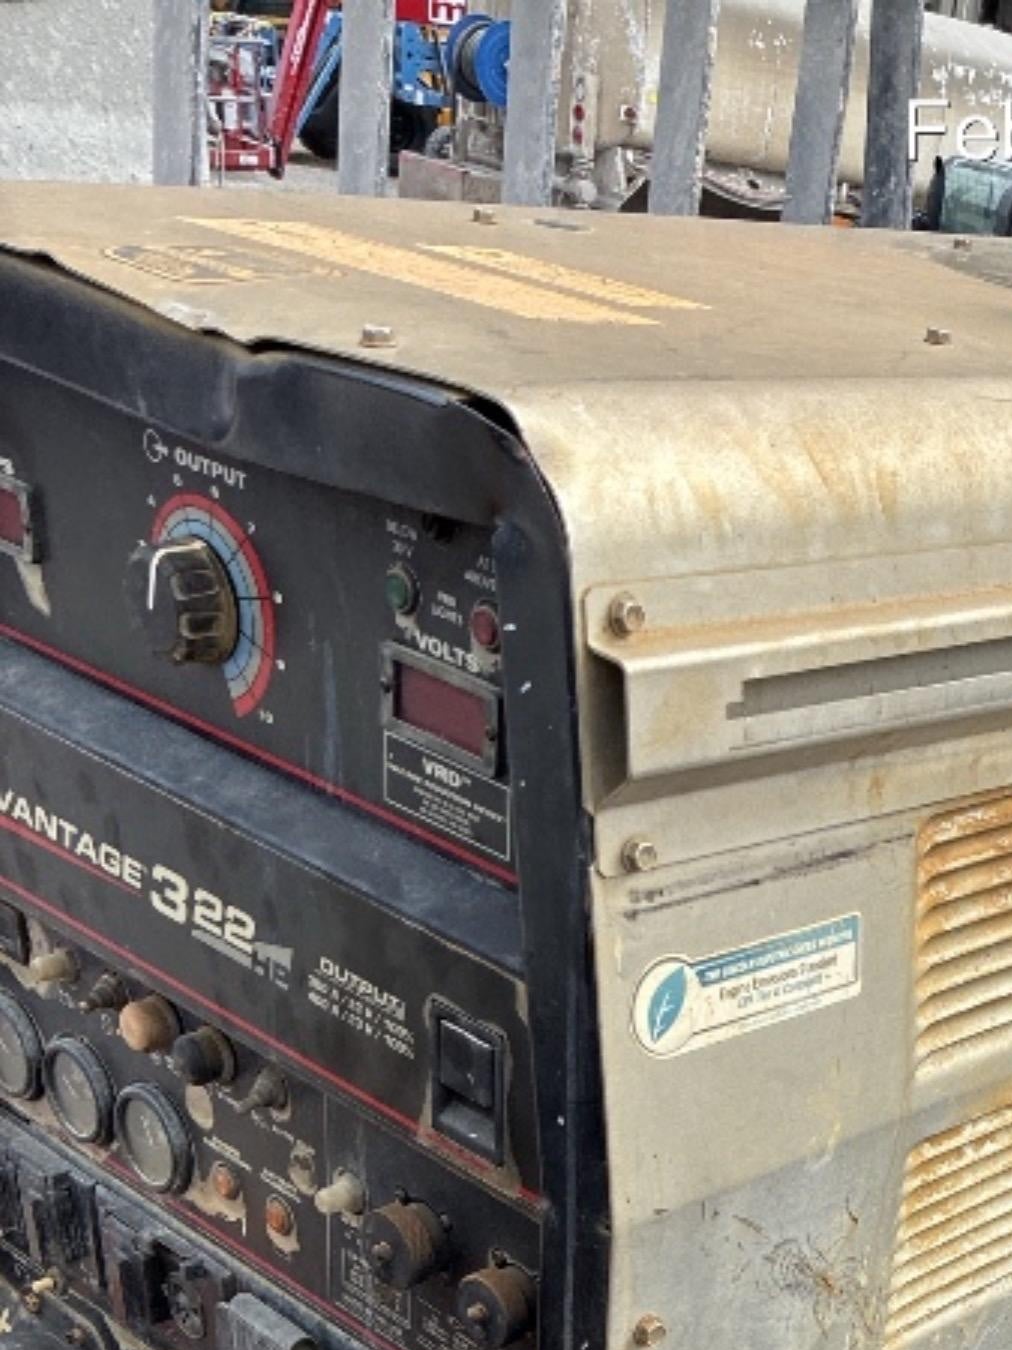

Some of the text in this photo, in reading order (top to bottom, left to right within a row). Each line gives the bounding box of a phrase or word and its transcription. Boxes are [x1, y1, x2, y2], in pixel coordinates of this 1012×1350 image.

[173, 446, 247, 489] OUTPUT
[413, 629, 480, 673] VOLTS
[0, 787, 256, 956] VANTAGE 322
